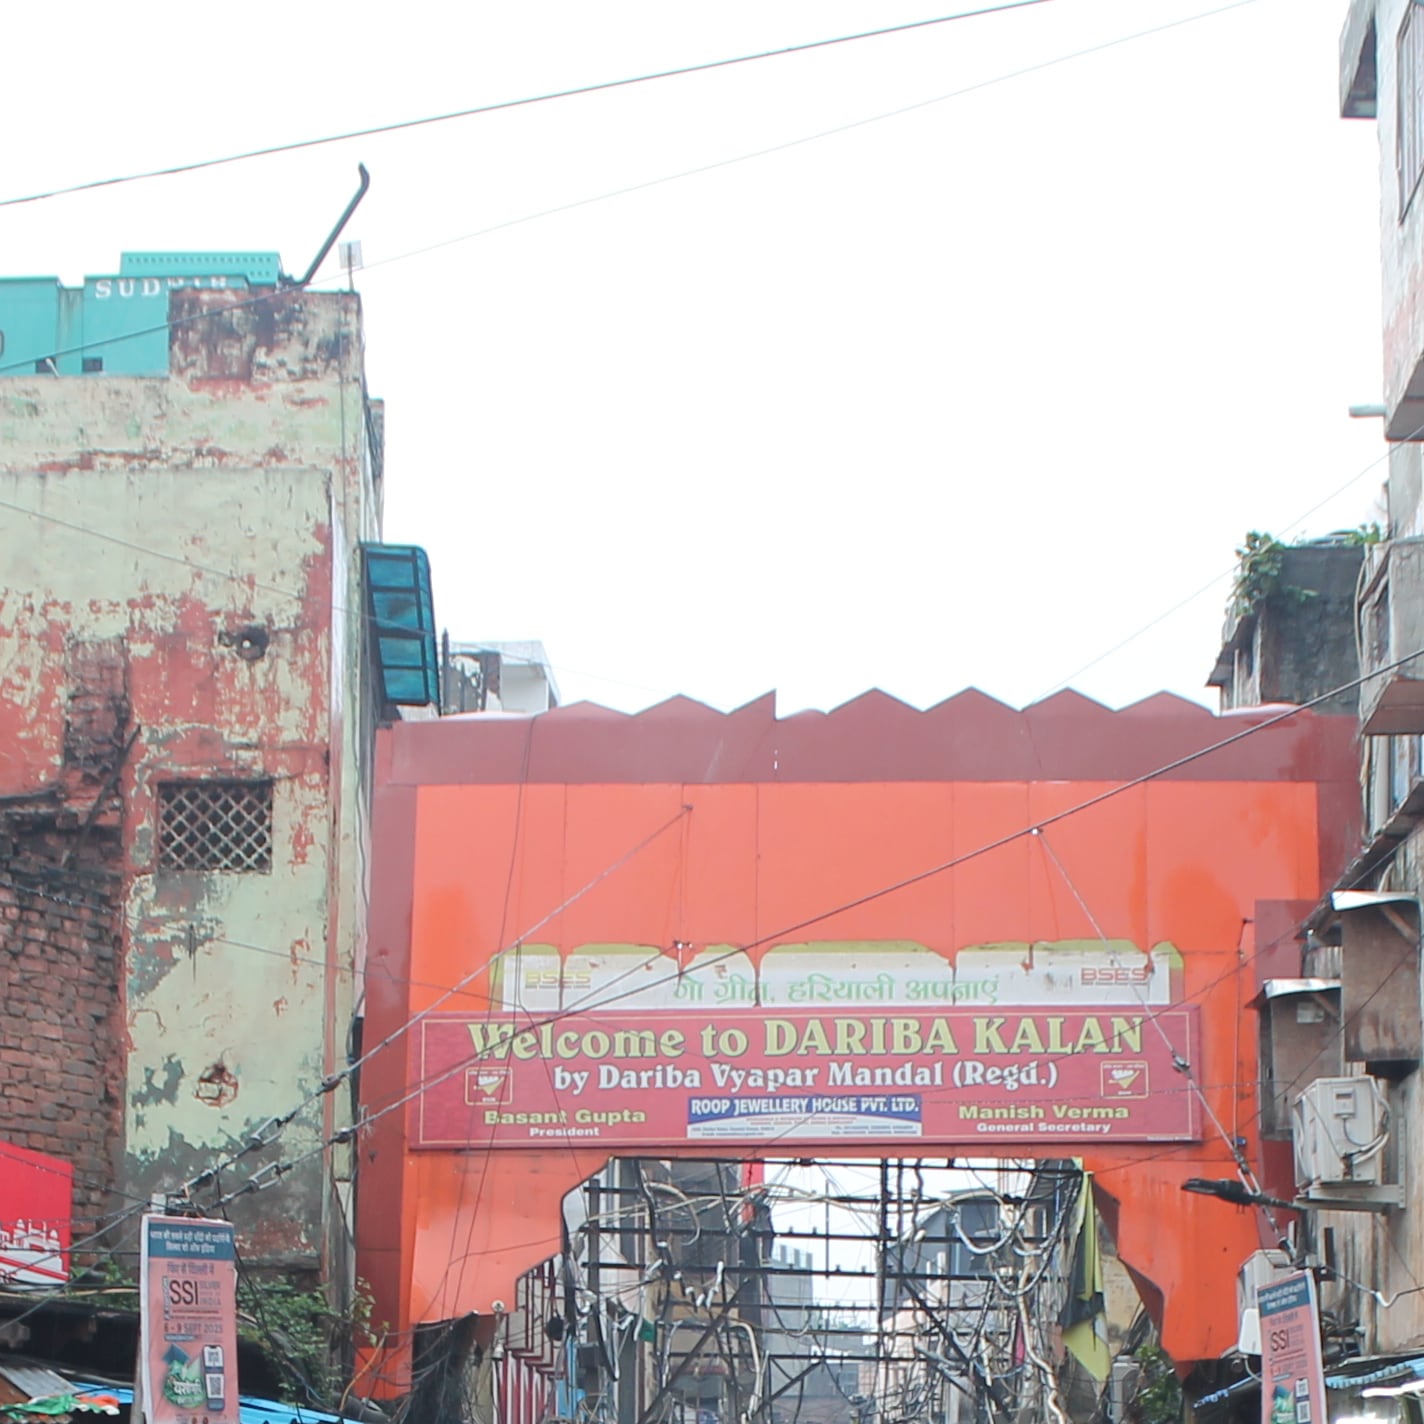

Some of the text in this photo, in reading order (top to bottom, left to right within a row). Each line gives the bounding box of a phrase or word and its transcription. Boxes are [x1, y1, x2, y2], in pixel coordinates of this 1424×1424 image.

[1080, 967, 1147, 984] BSES
[787, 973, 894, 1004] हरियाली
[467, 1016, 1144, 1061] Welcome to DARIBA KALAN
[554, 1060, 1059, 1095] by Dariba Vyapar Mandal (Regd.)
[690, 1096, 920, 1116] ROOP JEWELLERY HOUSE PVT. LTD.
[958, 1104, 1129, 1120] Manish Verma
[484, 1108, 646, 1127] Basant Gupta
[977, 1122, 1111, 1133] General Secretary
[529, 1127, 600, 1137] President
[169, 1280, 199, 1305] SSI
[1271, 1329, 1290, 1352] SSI
